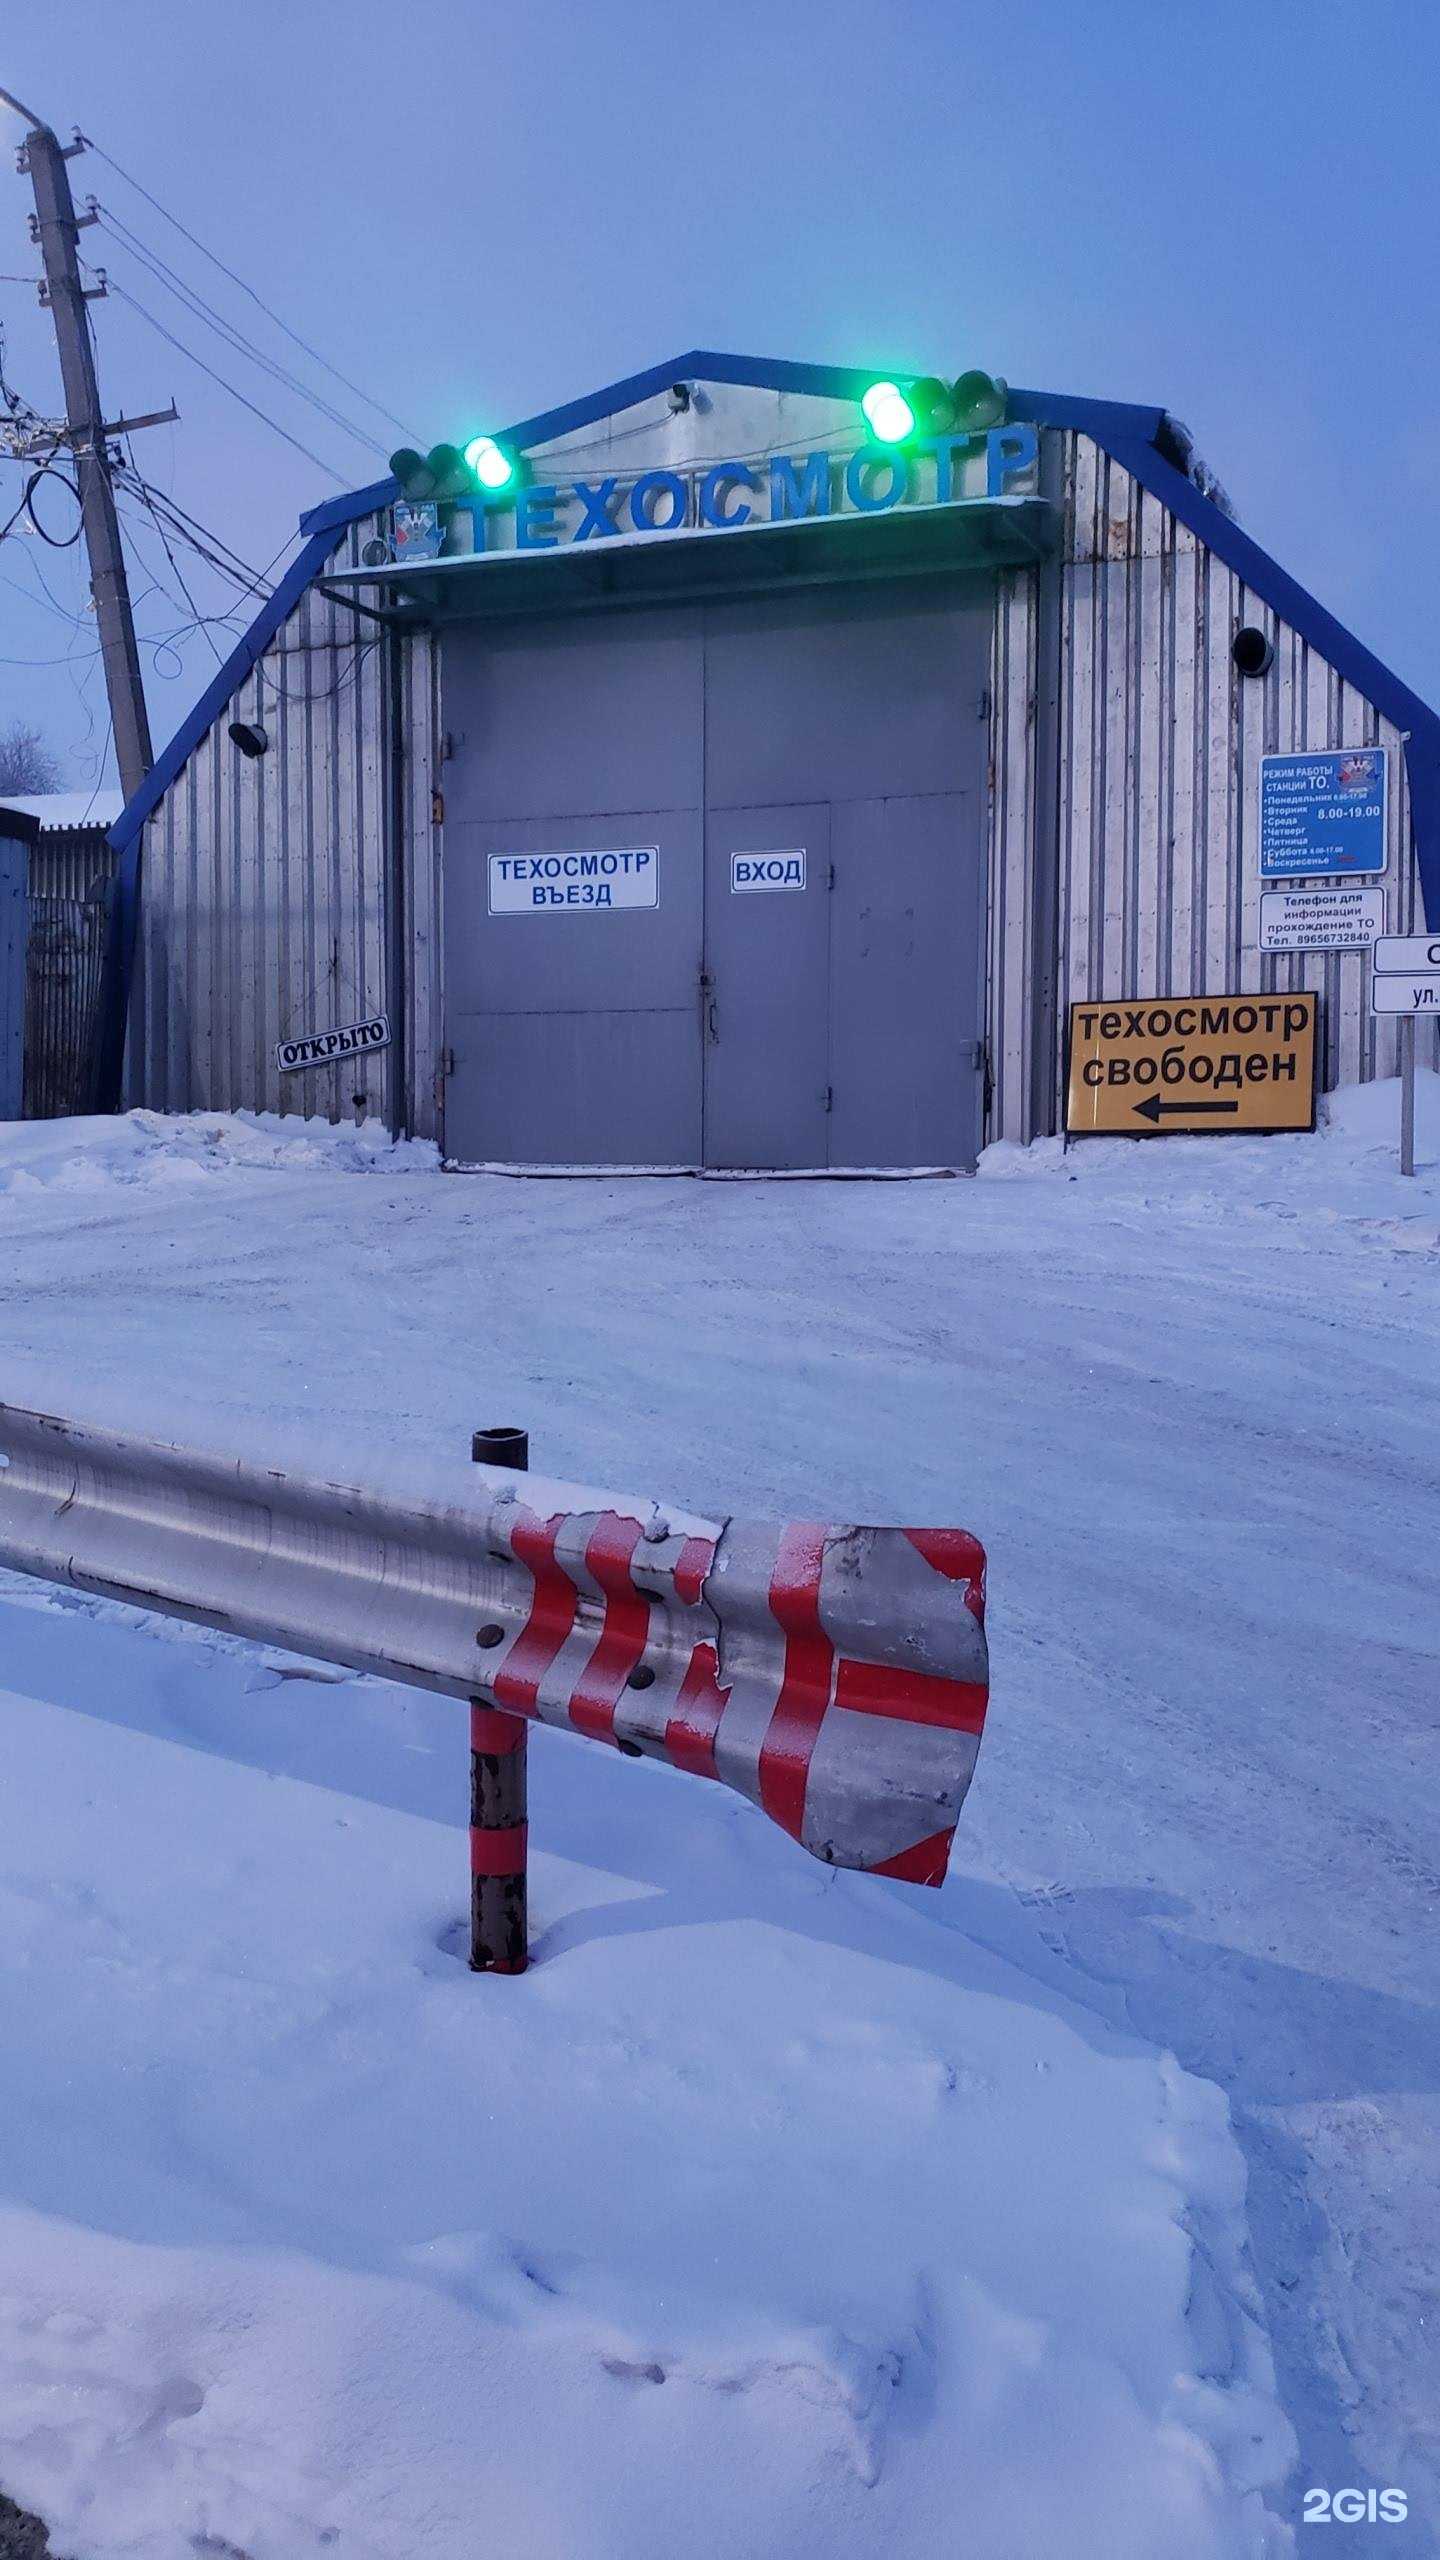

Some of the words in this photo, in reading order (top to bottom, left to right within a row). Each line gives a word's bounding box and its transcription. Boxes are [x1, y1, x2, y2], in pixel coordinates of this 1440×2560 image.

[453, 424, 1042, 553] ТЕХОСМОТР
[1263, 769, 1295, 780] РЕЖИМ
[1296, 766, 1333, 778] РАБОТЫ
[1266, 781, 1307, 792] СТАНЦИИ
[1317, 806, 1381, 820] 8.00-19.00
[1268, 818, 1298, 828] Среда
[497, 851, 651, 881] ТЕХОСМОТР
[735, 860, 801, 884] ВХОД
[532, 884, 612, 907] ВЪЕЗД
[1284, 895, 1338, 908] Телефон
[1340, 894, 1363, 904] для
[1284, 907, 1362, 921] информации
[1267, 920, 1354, 934] прохождение
[1357, 918, 1375, 929] ТО
[1266, 936, 1292, 947] Тел.
[1297, 932, 1370, 945] 89656732840
[1413, 988, 1438, 1009] ул.
[1078, 1003, 1309, 1042] техосмотр
[283, 1022, 384, 1064] ОТКРЫТО
[1083, 1045, 1297, 1089] свободен
